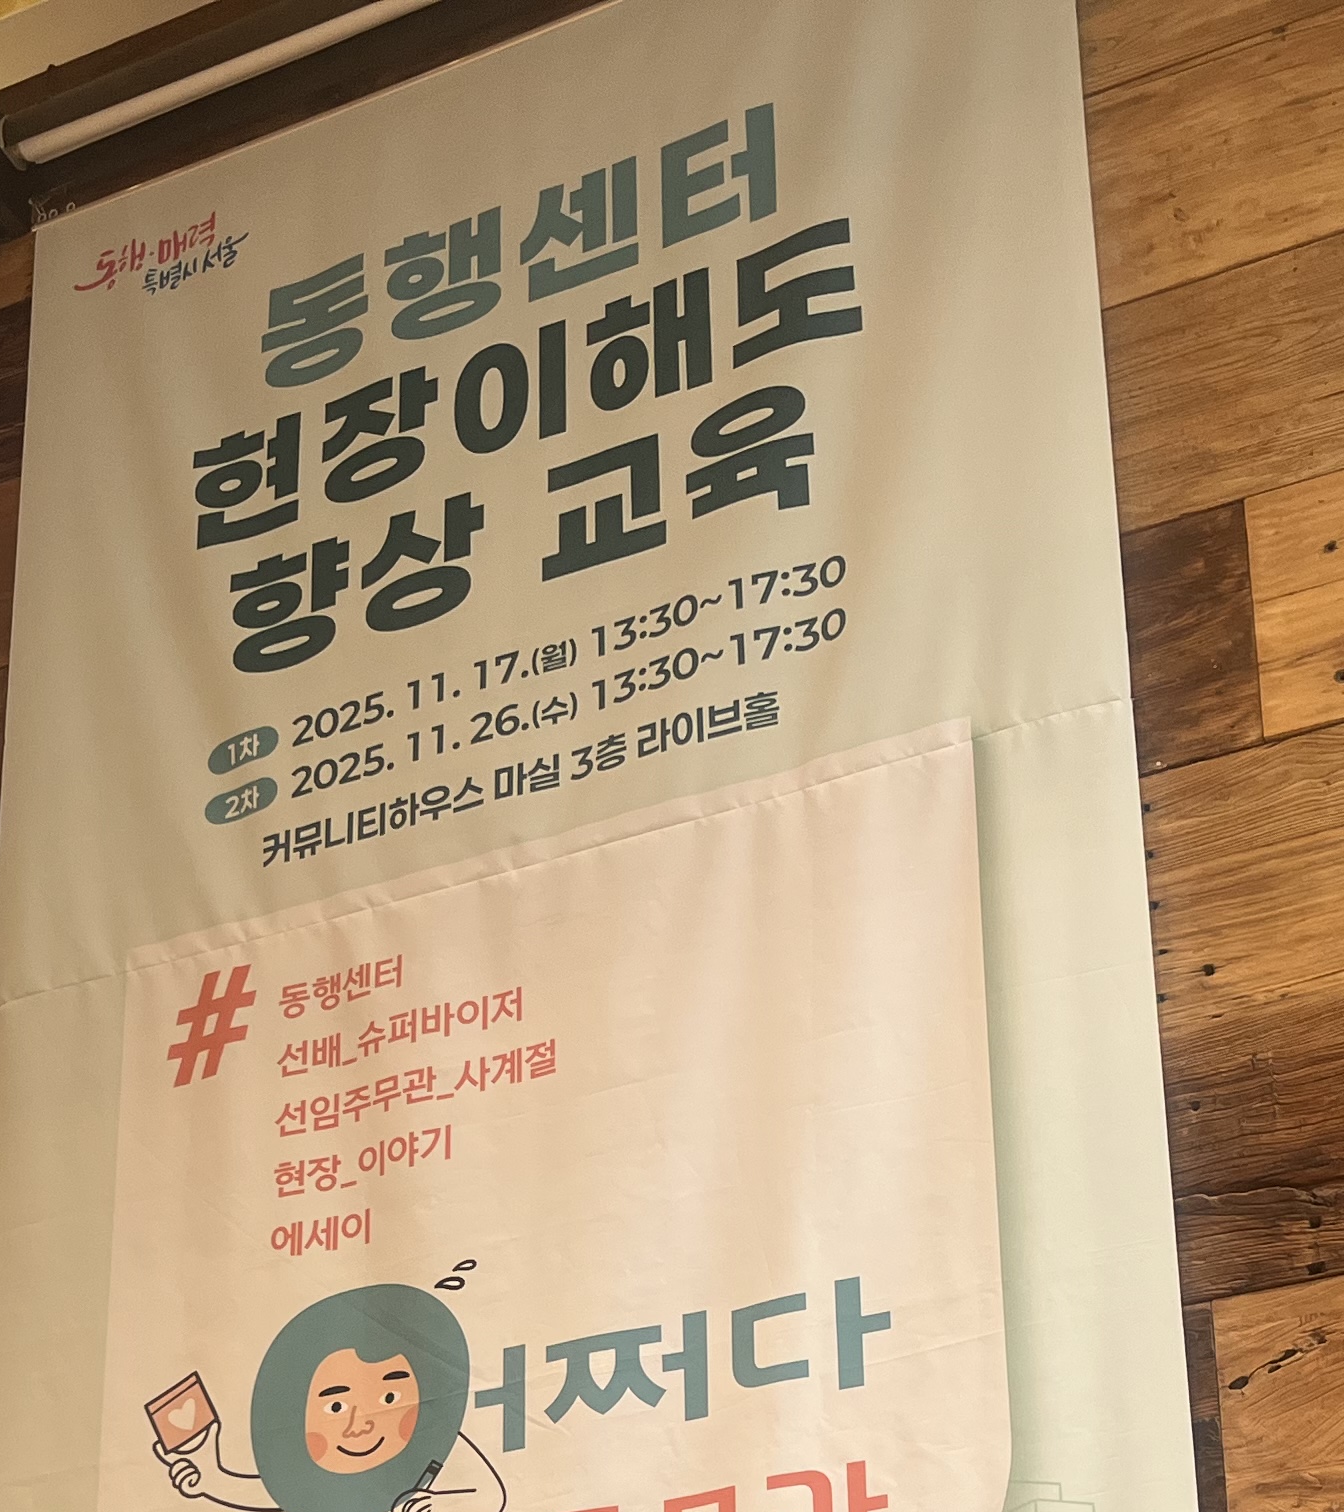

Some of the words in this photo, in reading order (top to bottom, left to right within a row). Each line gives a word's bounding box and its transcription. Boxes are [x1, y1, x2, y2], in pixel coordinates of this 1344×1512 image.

[142, 257, 198, 296] 특별시
[202, 232, 249, 273] 서울
[261, 103, 778, 388] 동행센터
[192, 216, 865, 549] 현장이해도
[230, 492, 484, 674] 향상
[541, 385, 815, 581] 교육
[292, 692, 394, 748] 2025.
[407, 675, 460, 709] 11.
[592, 554, 847, 658] 13:30~17:30
[226, 731, 260, 767] 1차
[290, 745, 395, 799] 2025.
[406, 728, 461, 763] 11.
[592, 608, 847, 711] 13:30~17:30
[225, 781, 262, 819] 2차
[262, 785, 485, 867] 커뮤니티하우스
[493, 754, 560, 801] 마실
[570, 735, 628, 782] 3층
[637, 690, 780, 758] 라이브홀
[275, 987, 524, 1079] 선배_슈퍼바이저
[277, 955, 403, 1021] 동행센터
[274, 1039, 558, 1138] 선임주무관_사계절
[273, 1125, 453, 1200] 현장_이야기
[270, 1209, 373, 1258] 에세이
